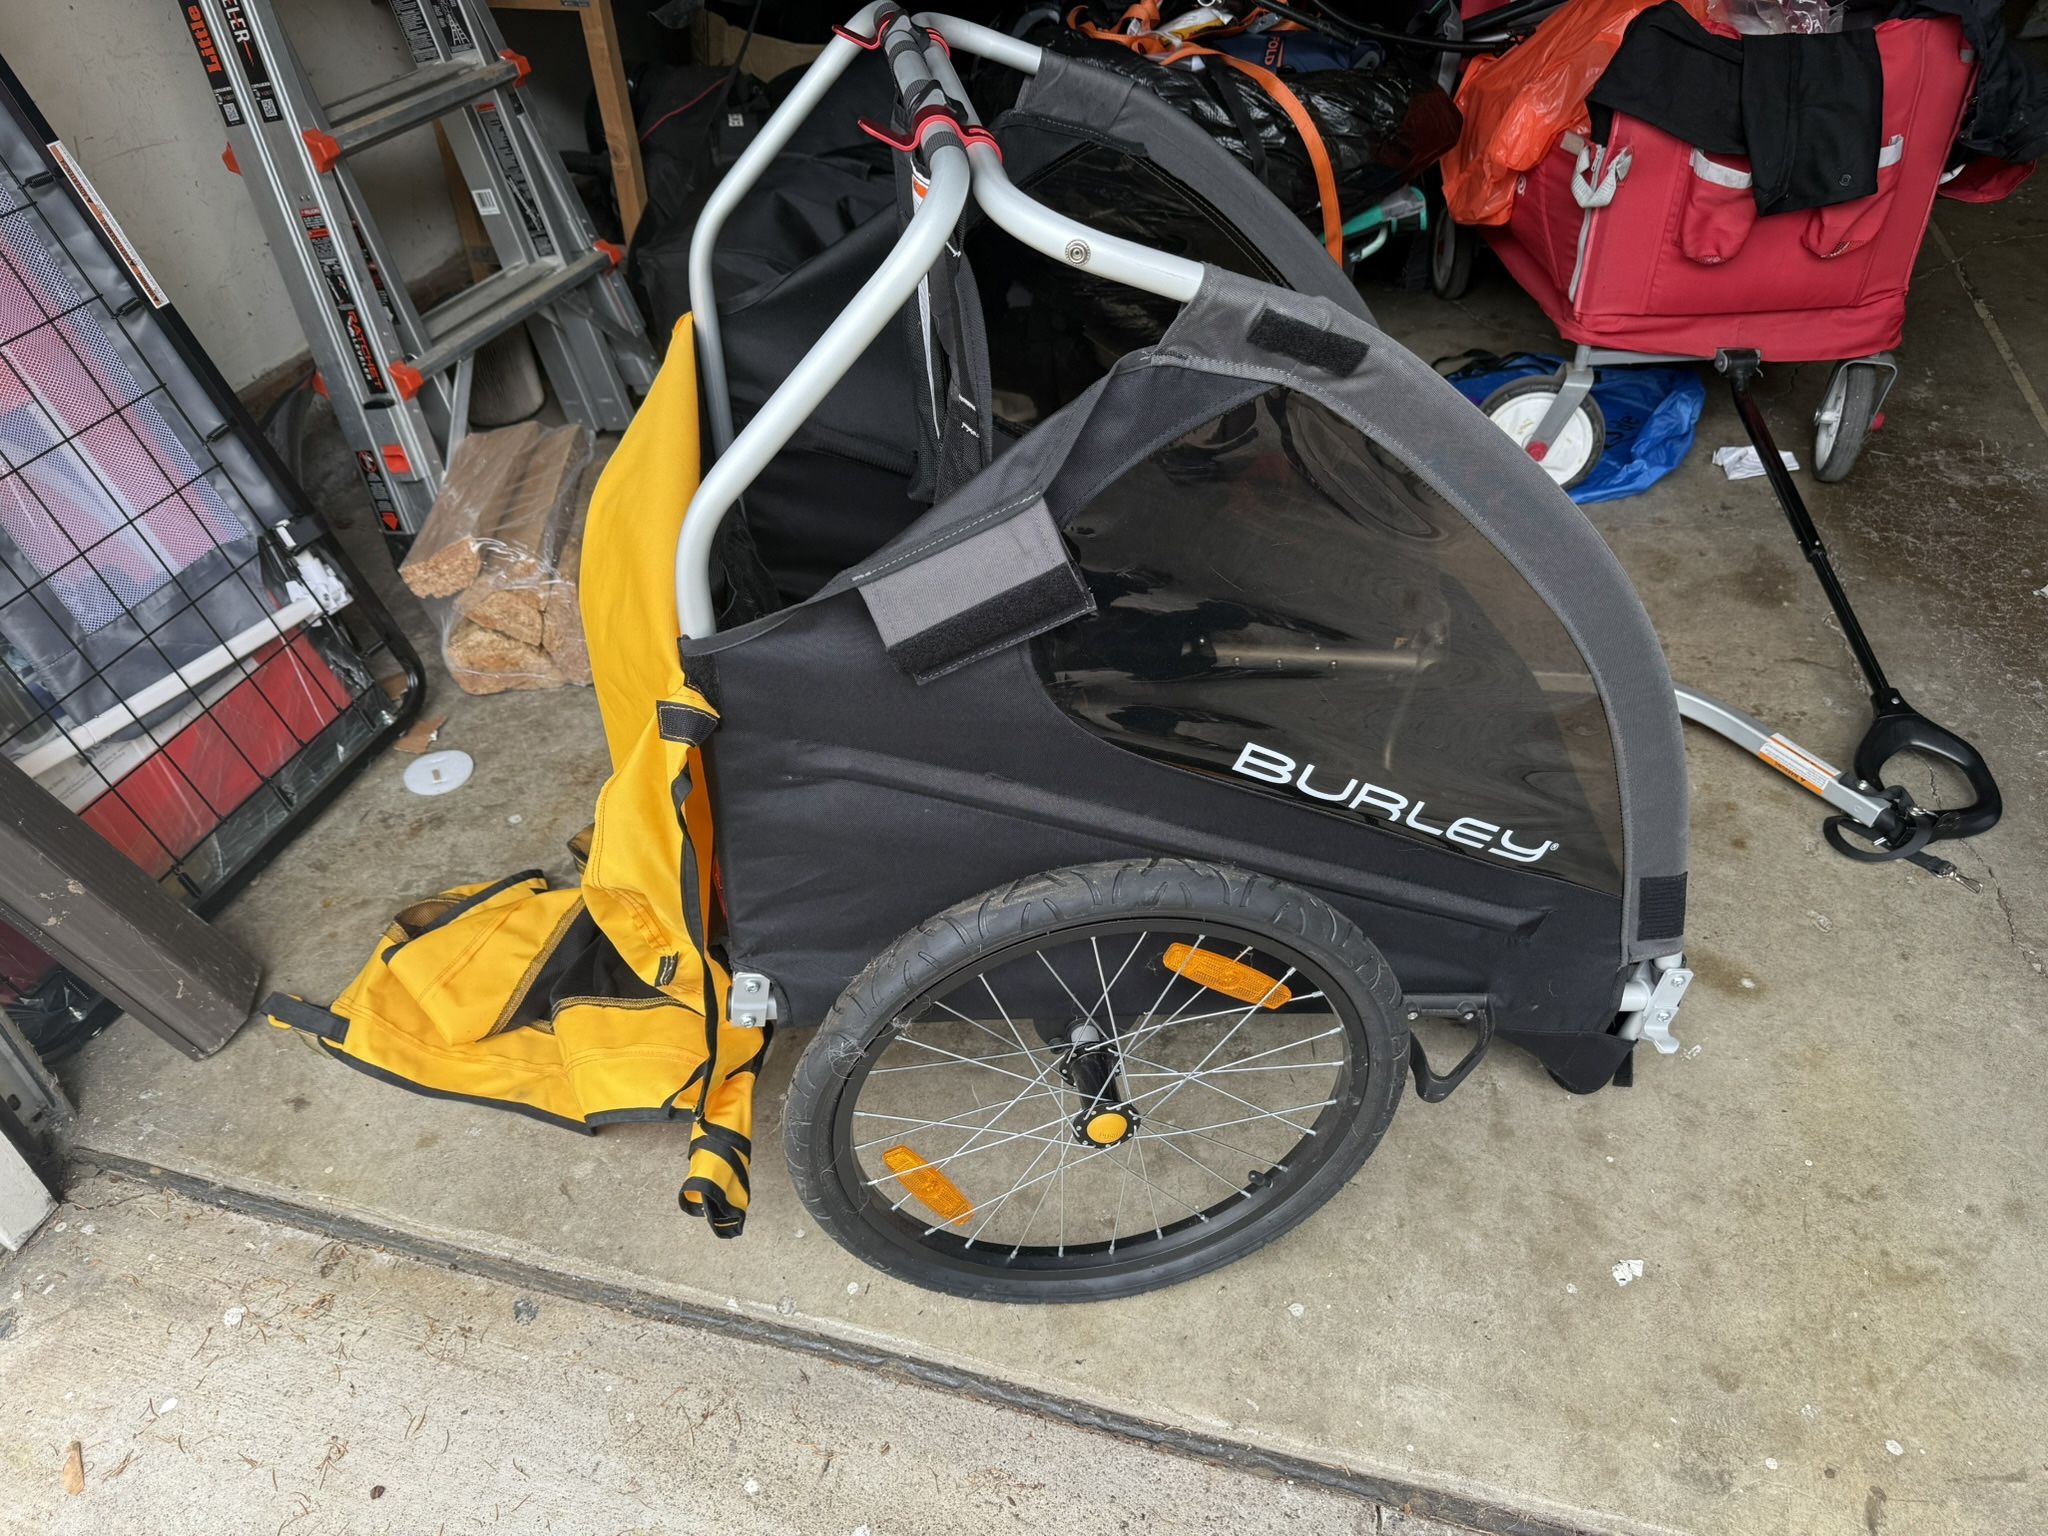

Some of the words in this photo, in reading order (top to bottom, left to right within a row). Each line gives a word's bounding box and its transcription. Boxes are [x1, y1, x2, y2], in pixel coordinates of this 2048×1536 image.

[187, 5, 223, 74] Little
[347, 310, 384, 389] RATCHET
[1231, 741, 1554, 863] BURLEY
